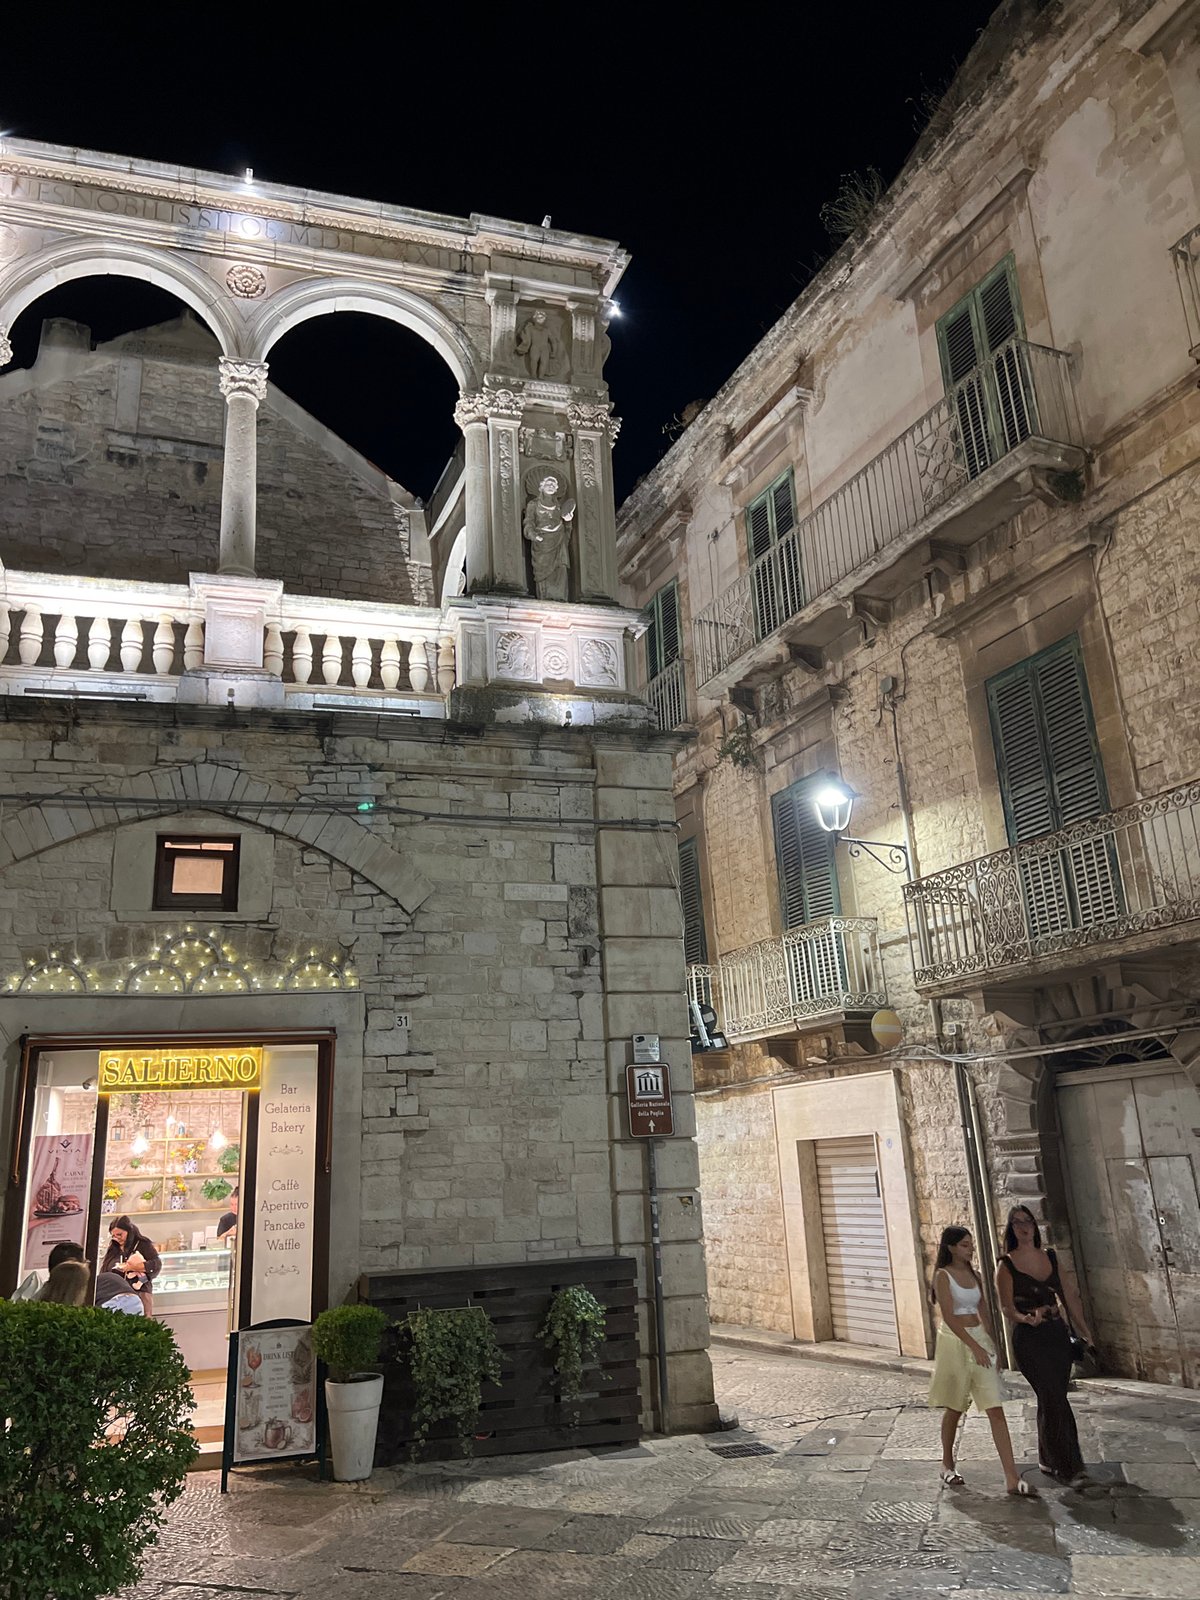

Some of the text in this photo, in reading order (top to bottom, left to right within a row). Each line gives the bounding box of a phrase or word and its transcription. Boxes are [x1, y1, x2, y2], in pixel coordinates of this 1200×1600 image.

[397, 1015, 408, 1027] 31
[102, 1054, 258, 1085] SALIERNO
[281, 1083, 298, 1095] Bar
[265, 1102, 311, 1114] Gelateria
[271, 1121, 305, 1134] Bakery
[272, 1179, 299, 1191] Caffè
[260, 1200, 309, 1213] Aperitivo
[264, 1218, 305, 1231] Pancake
[266, 1238, 301, 1250] Waffle
